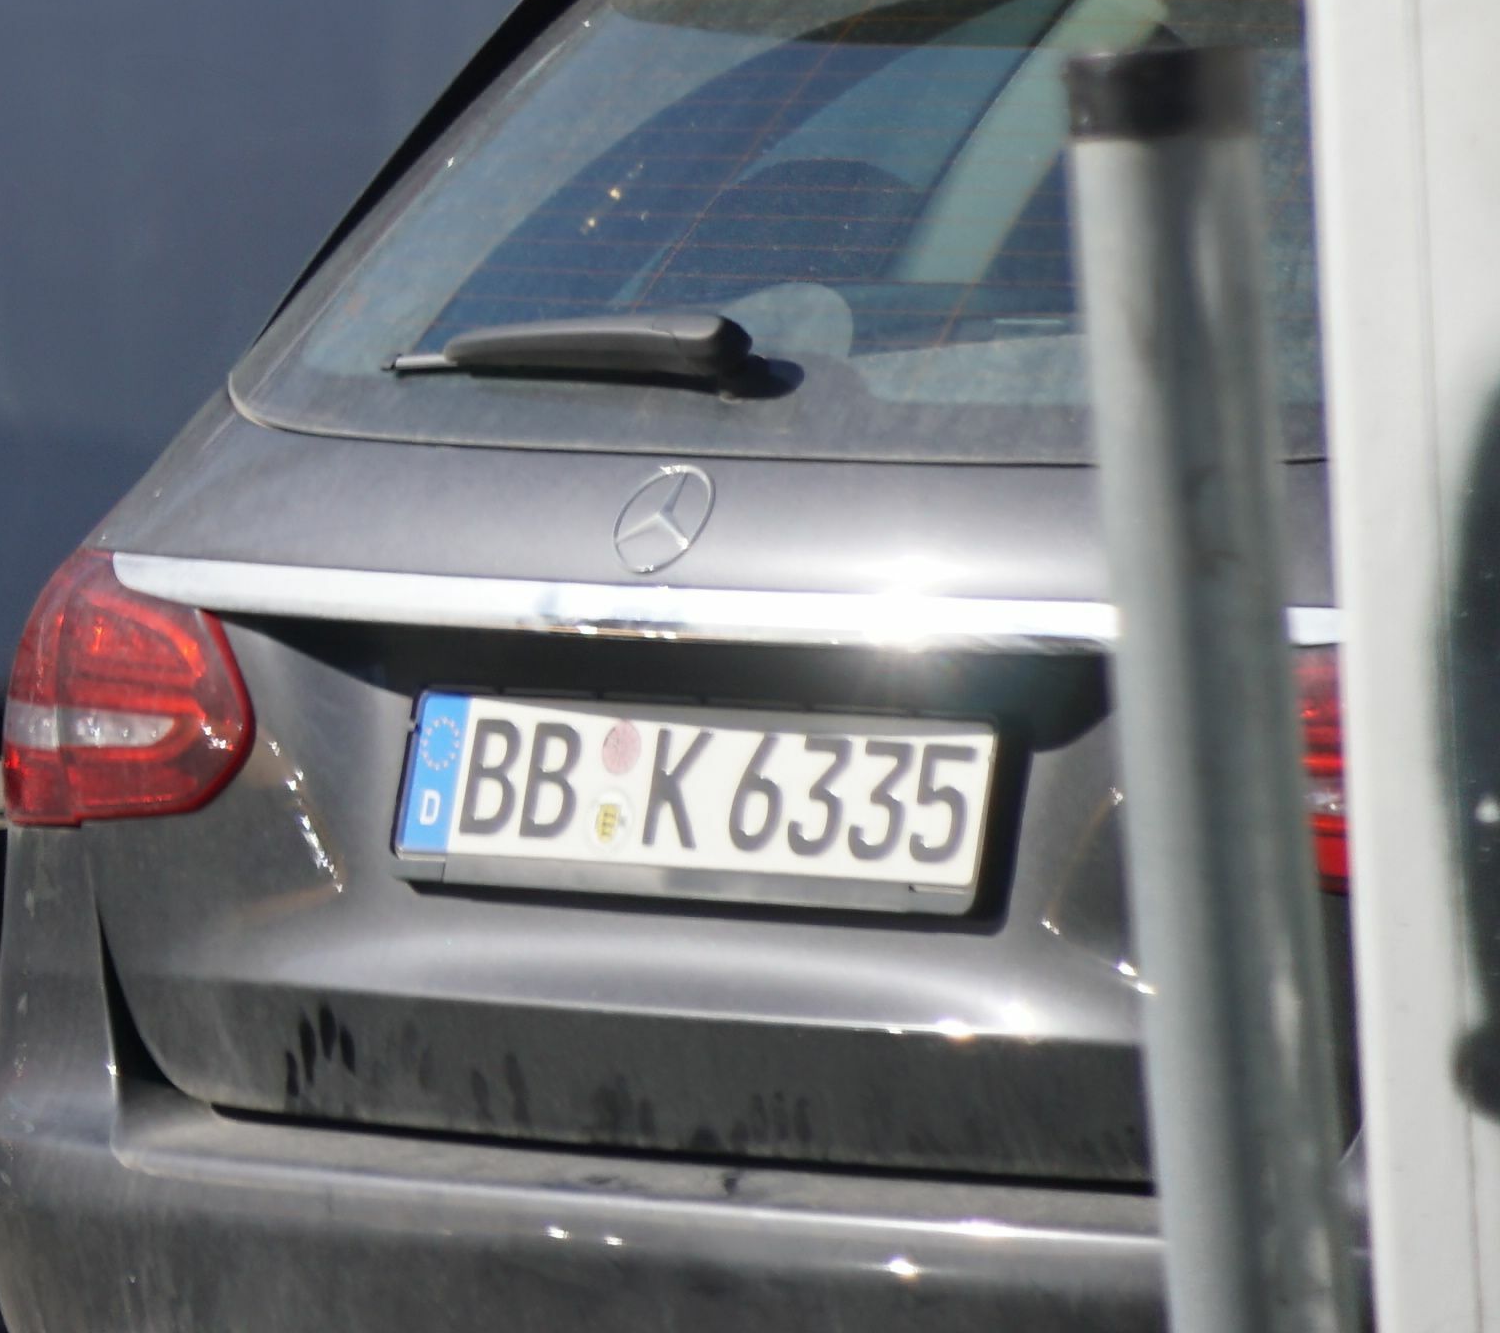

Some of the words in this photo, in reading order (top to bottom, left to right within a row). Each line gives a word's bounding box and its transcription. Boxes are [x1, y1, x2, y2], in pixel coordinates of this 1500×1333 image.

[457, 717, 583, 839] BB
[640, 727, 714, 851] K
[727, 731, 979, 865] 6335
